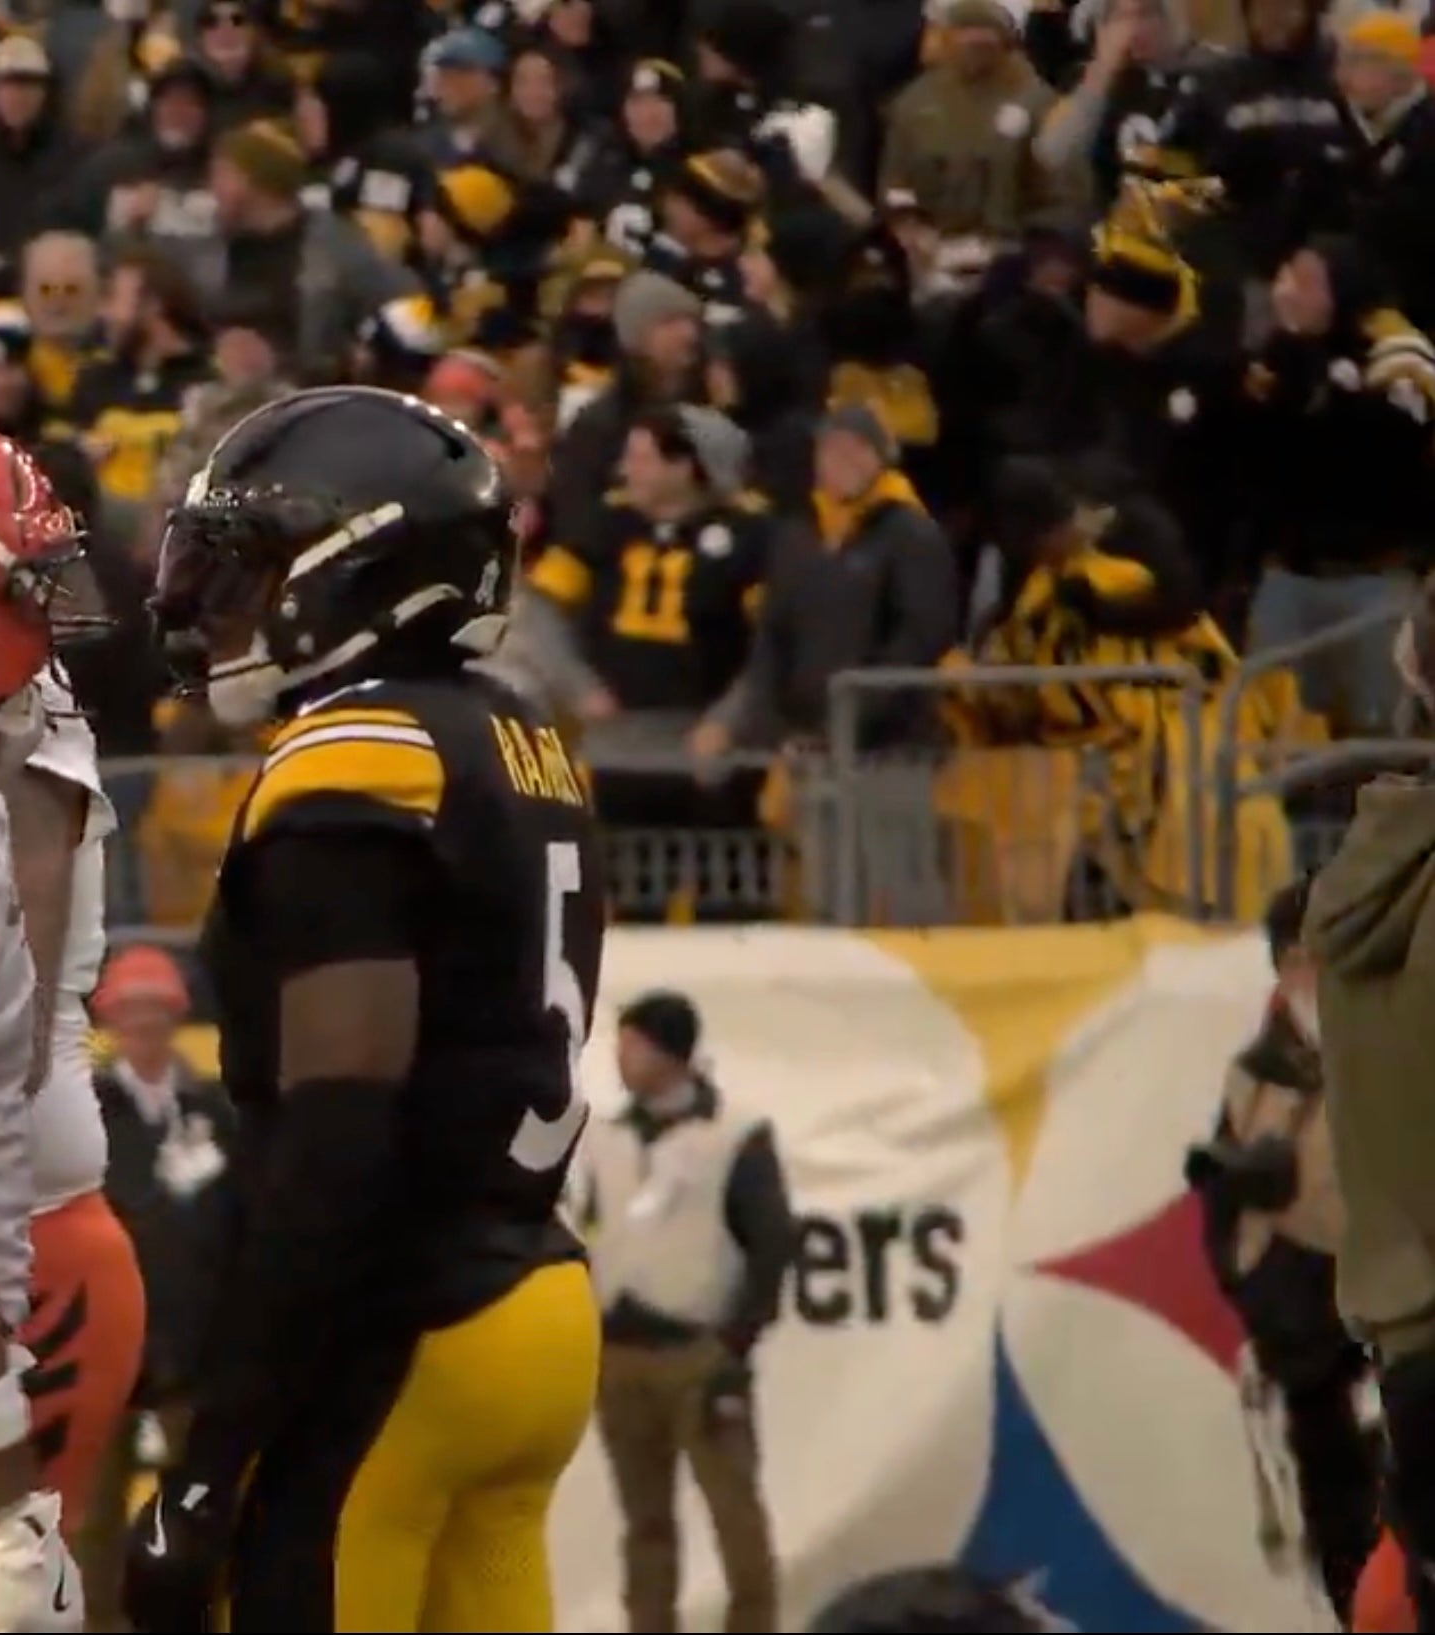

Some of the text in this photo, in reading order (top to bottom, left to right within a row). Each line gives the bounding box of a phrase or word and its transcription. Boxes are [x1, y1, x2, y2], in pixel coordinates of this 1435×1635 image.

[613, 543, 691, 641] 11
[508, 842, 589, 1172] 5
[775, 1205, 964, 1325] ers
